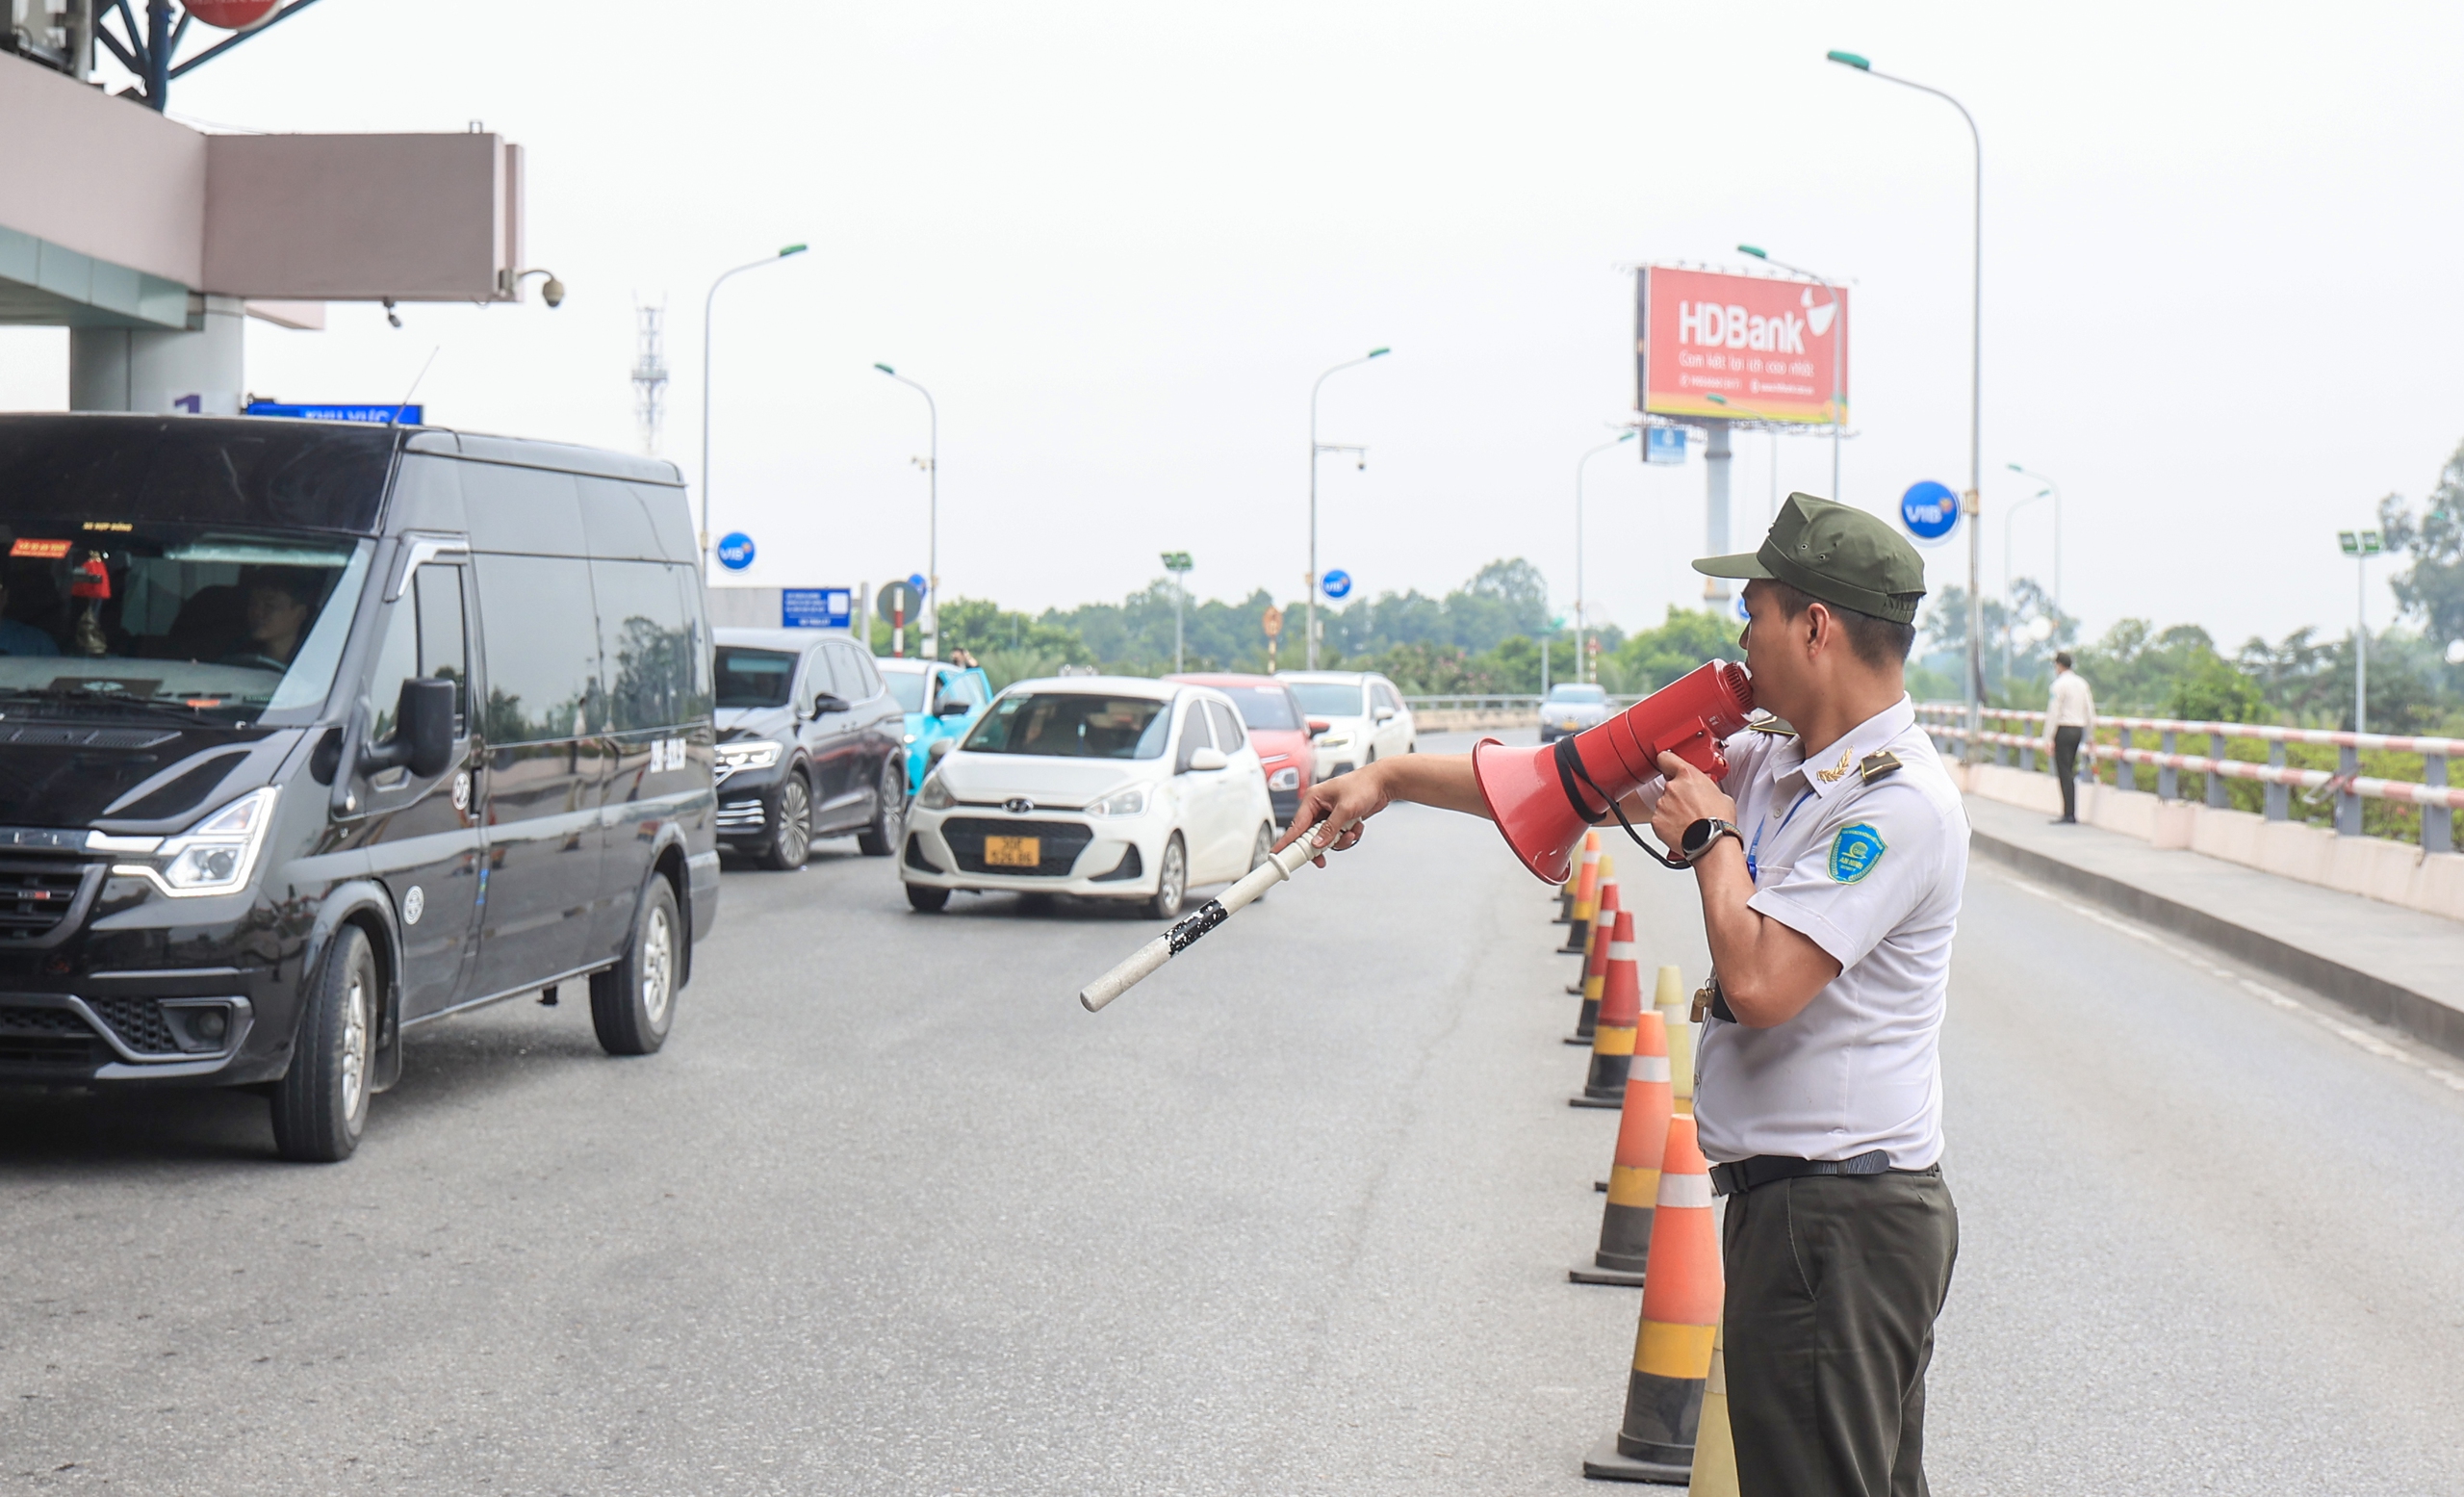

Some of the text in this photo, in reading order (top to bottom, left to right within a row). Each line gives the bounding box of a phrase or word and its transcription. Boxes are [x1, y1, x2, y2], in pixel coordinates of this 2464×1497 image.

[1679, 299, 1806, 354] HDBank
[1905, 504, 1943, 524] VIB
[719, 547, 745, 561] VIB
